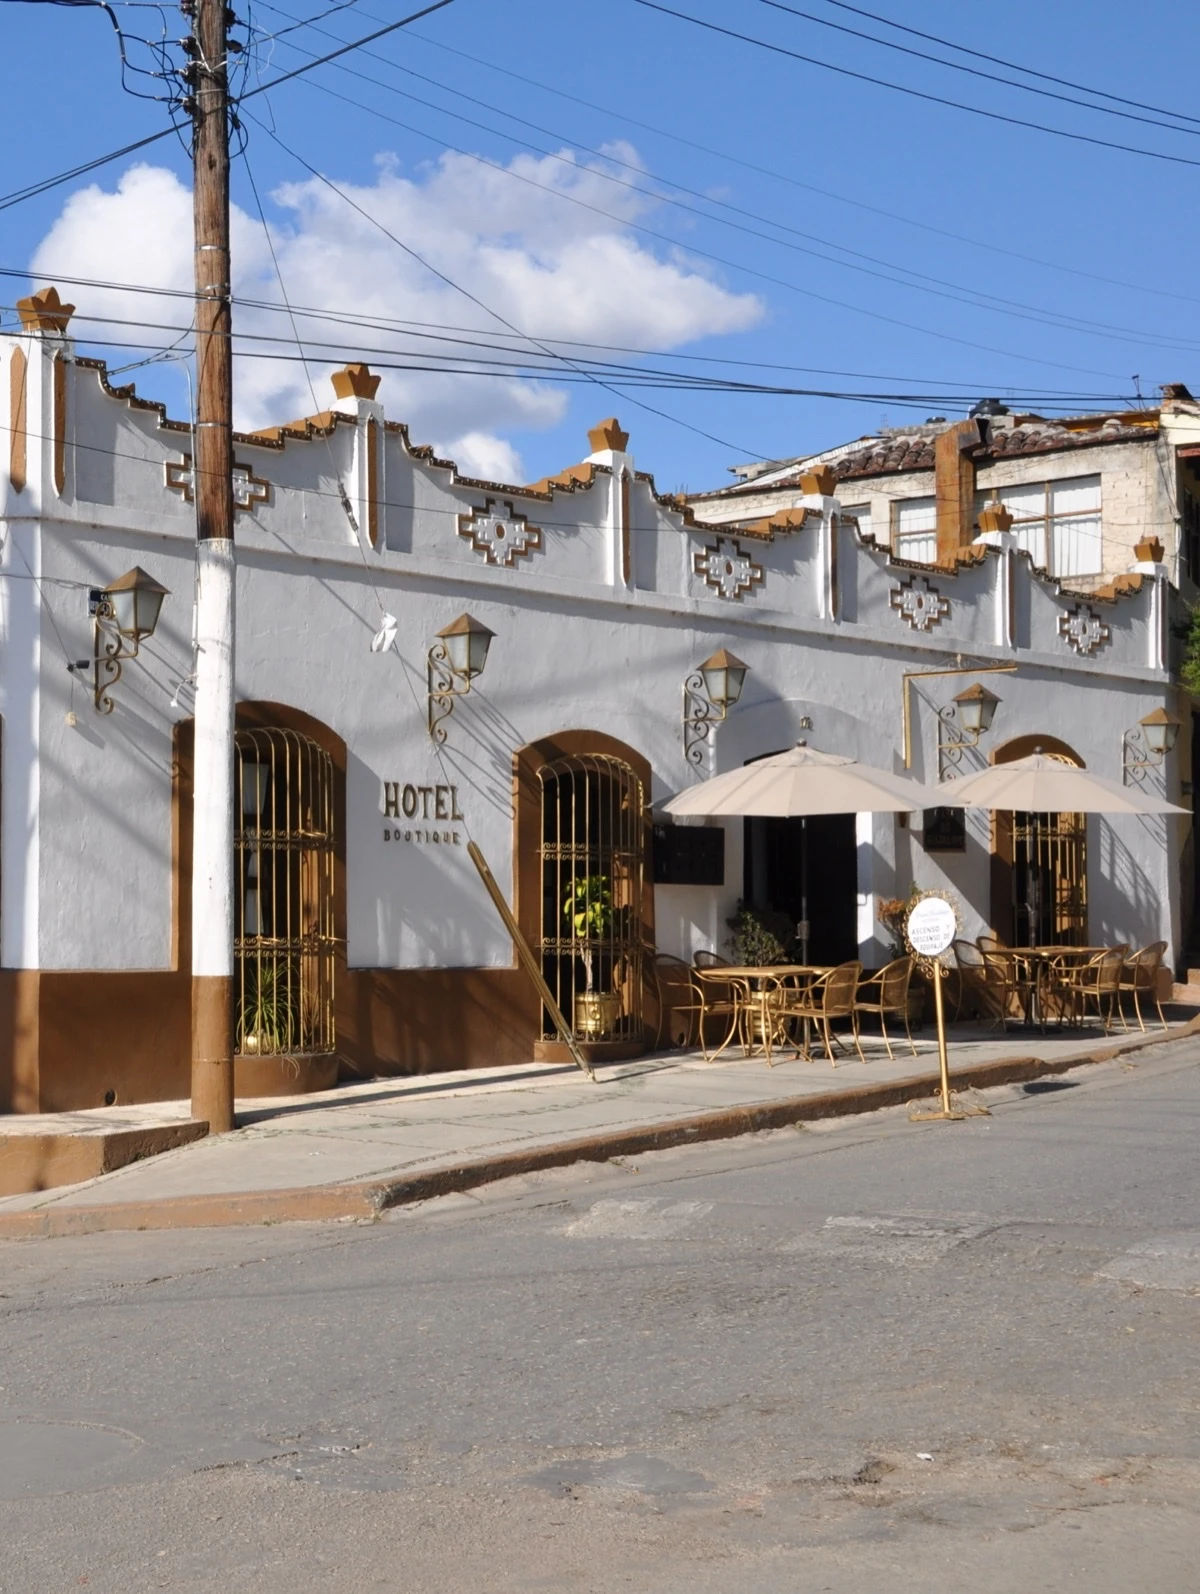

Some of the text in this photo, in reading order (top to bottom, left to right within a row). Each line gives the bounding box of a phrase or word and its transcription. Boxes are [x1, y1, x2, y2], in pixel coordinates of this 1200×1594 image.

[383, 782, 465, 820] HOTEL
[383, 829, 461, 845] BOUTIQUE
[911, 925, 940, 935] ASCENSO
[912, 934, 941, 944] DESCENSO
[919, 942, 943, 952] EQUIPAJE
